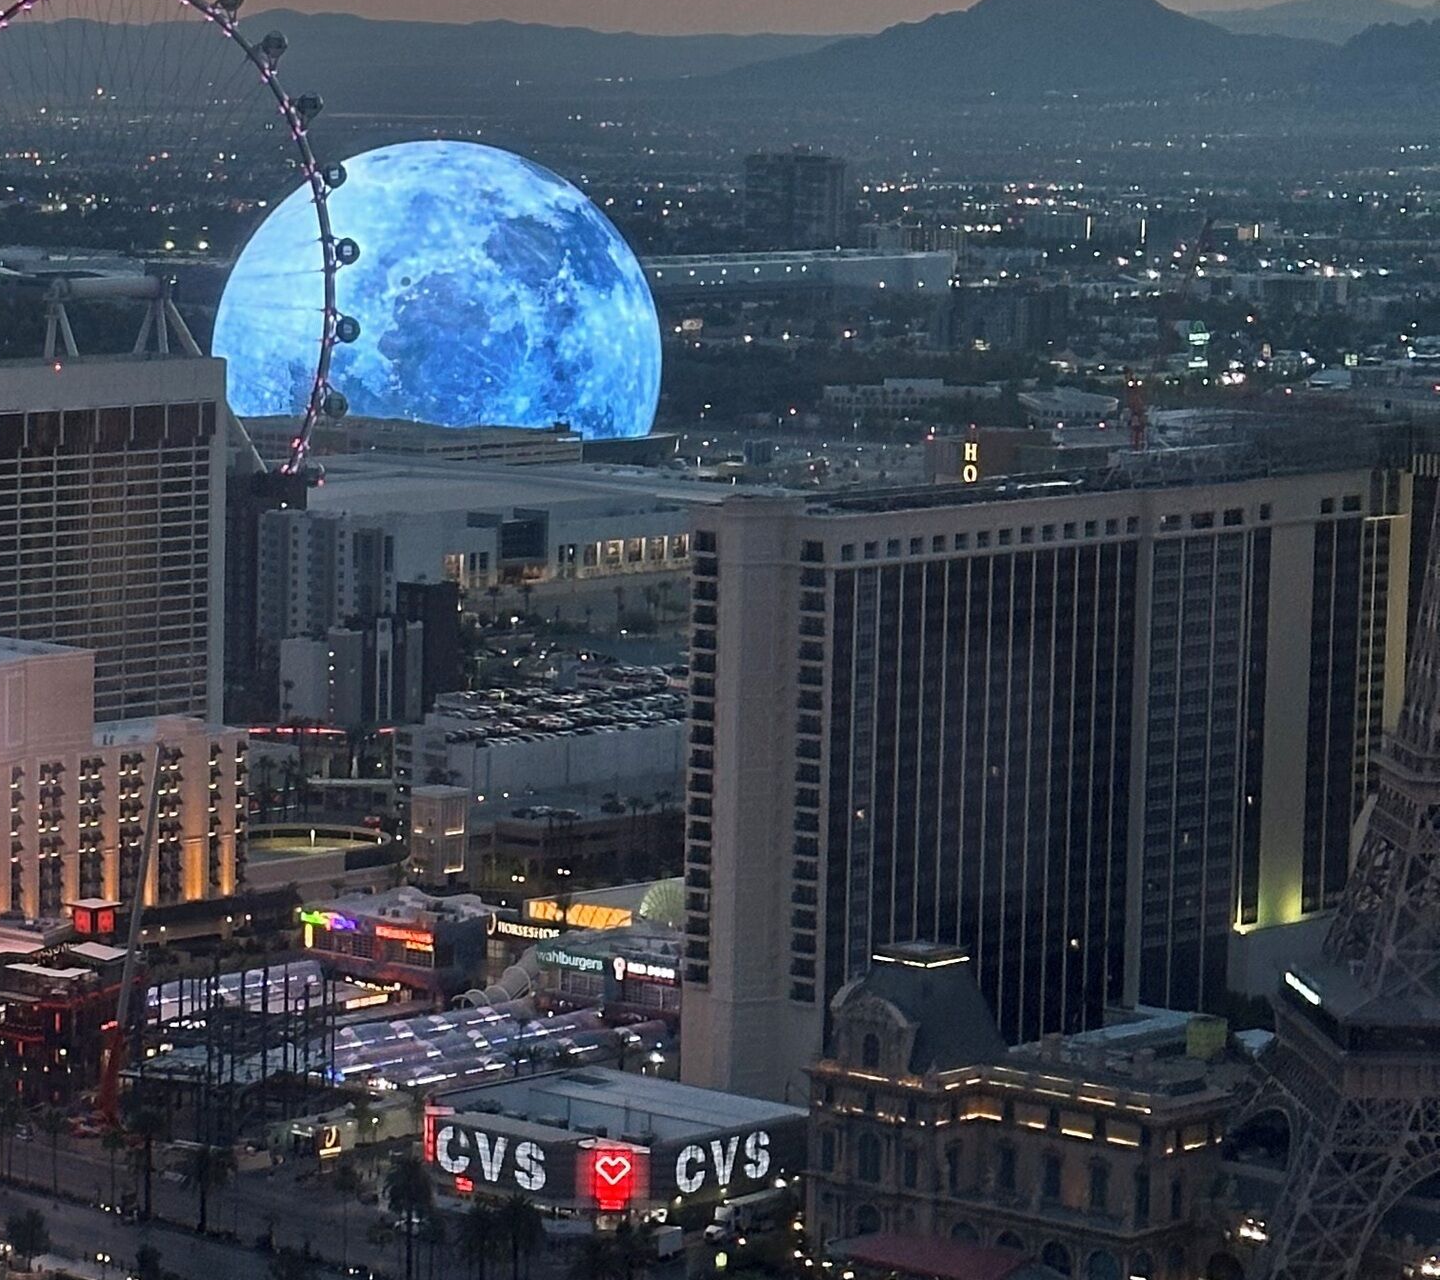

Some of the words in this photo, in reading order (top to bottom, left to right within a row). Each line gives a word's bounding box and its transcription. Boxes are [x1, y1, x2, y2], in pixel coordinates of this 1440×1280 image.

[535, 949, 603, 970] wahlburgers
[436, 1125, 547, 1191] CVS
[675, 1130, 771, 1194] CVS
